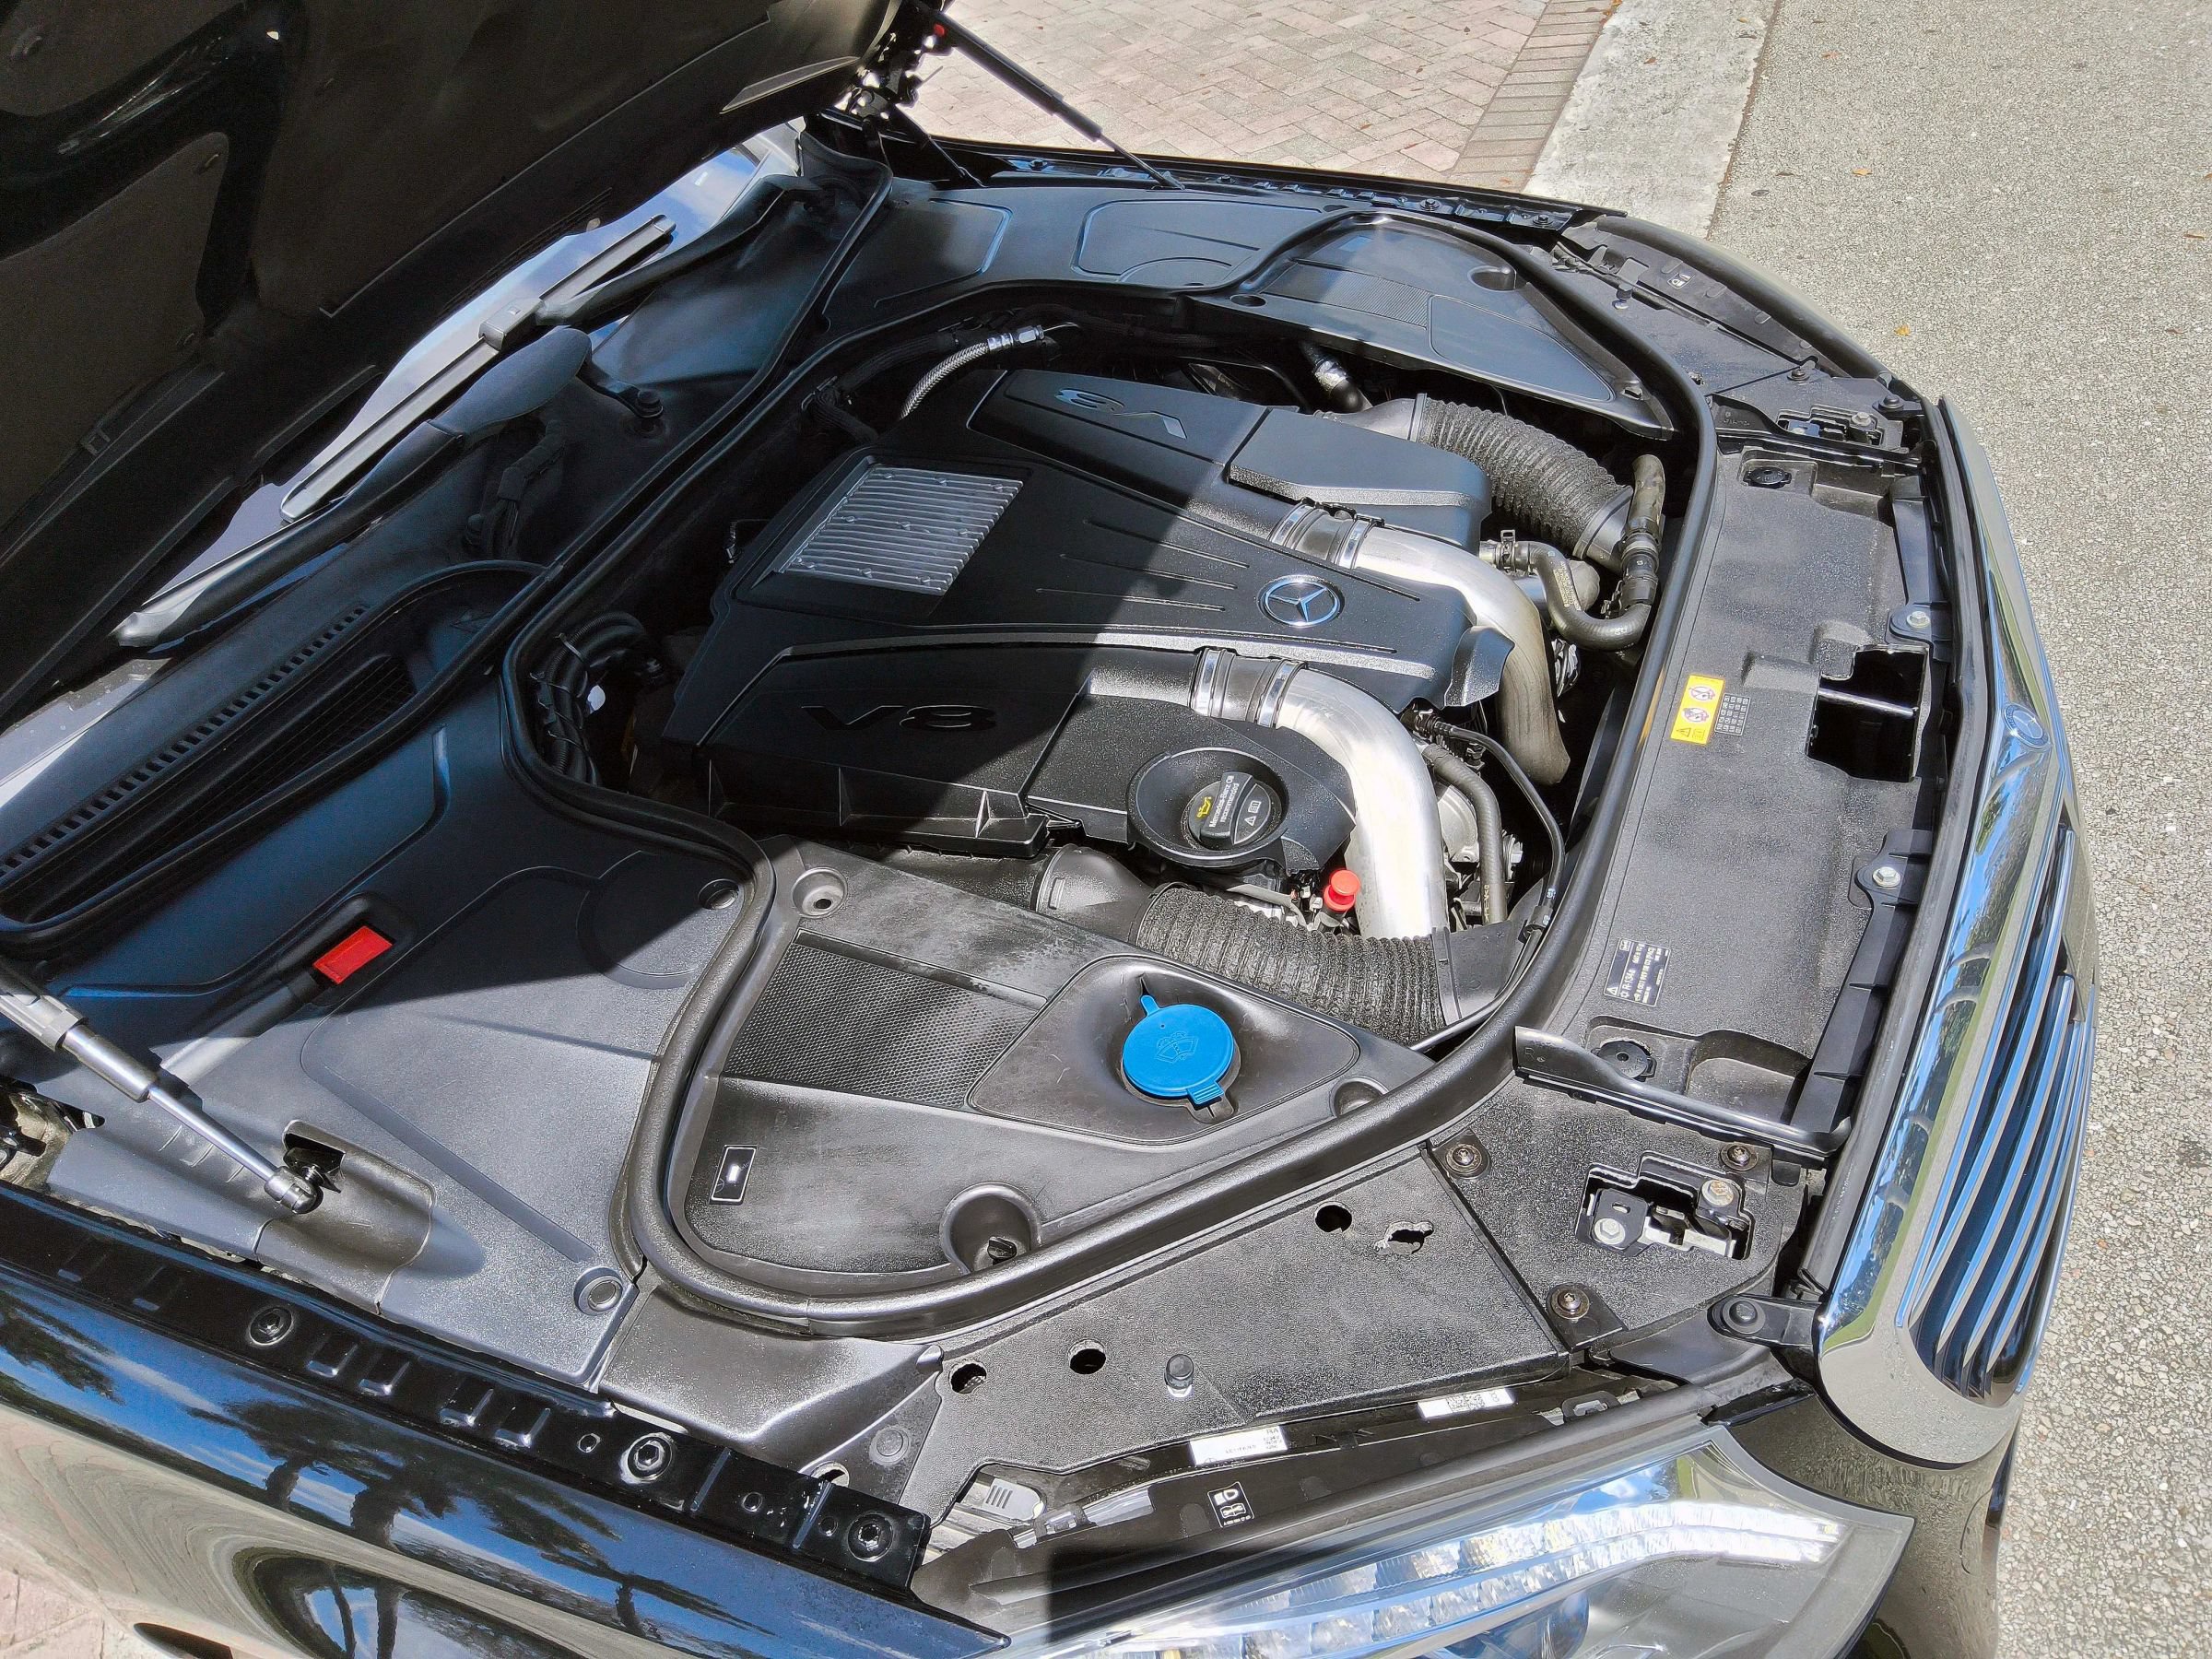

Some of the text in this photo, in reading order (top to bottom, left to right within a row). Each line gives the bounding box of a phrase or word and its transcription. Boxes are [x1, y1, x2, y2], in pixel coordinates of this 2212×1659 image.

[801, 703, 997, 733] V8
[1208, 783, 1231, 828] Mercedes-Benz
[1219, 782, 1240, 823] recommended
